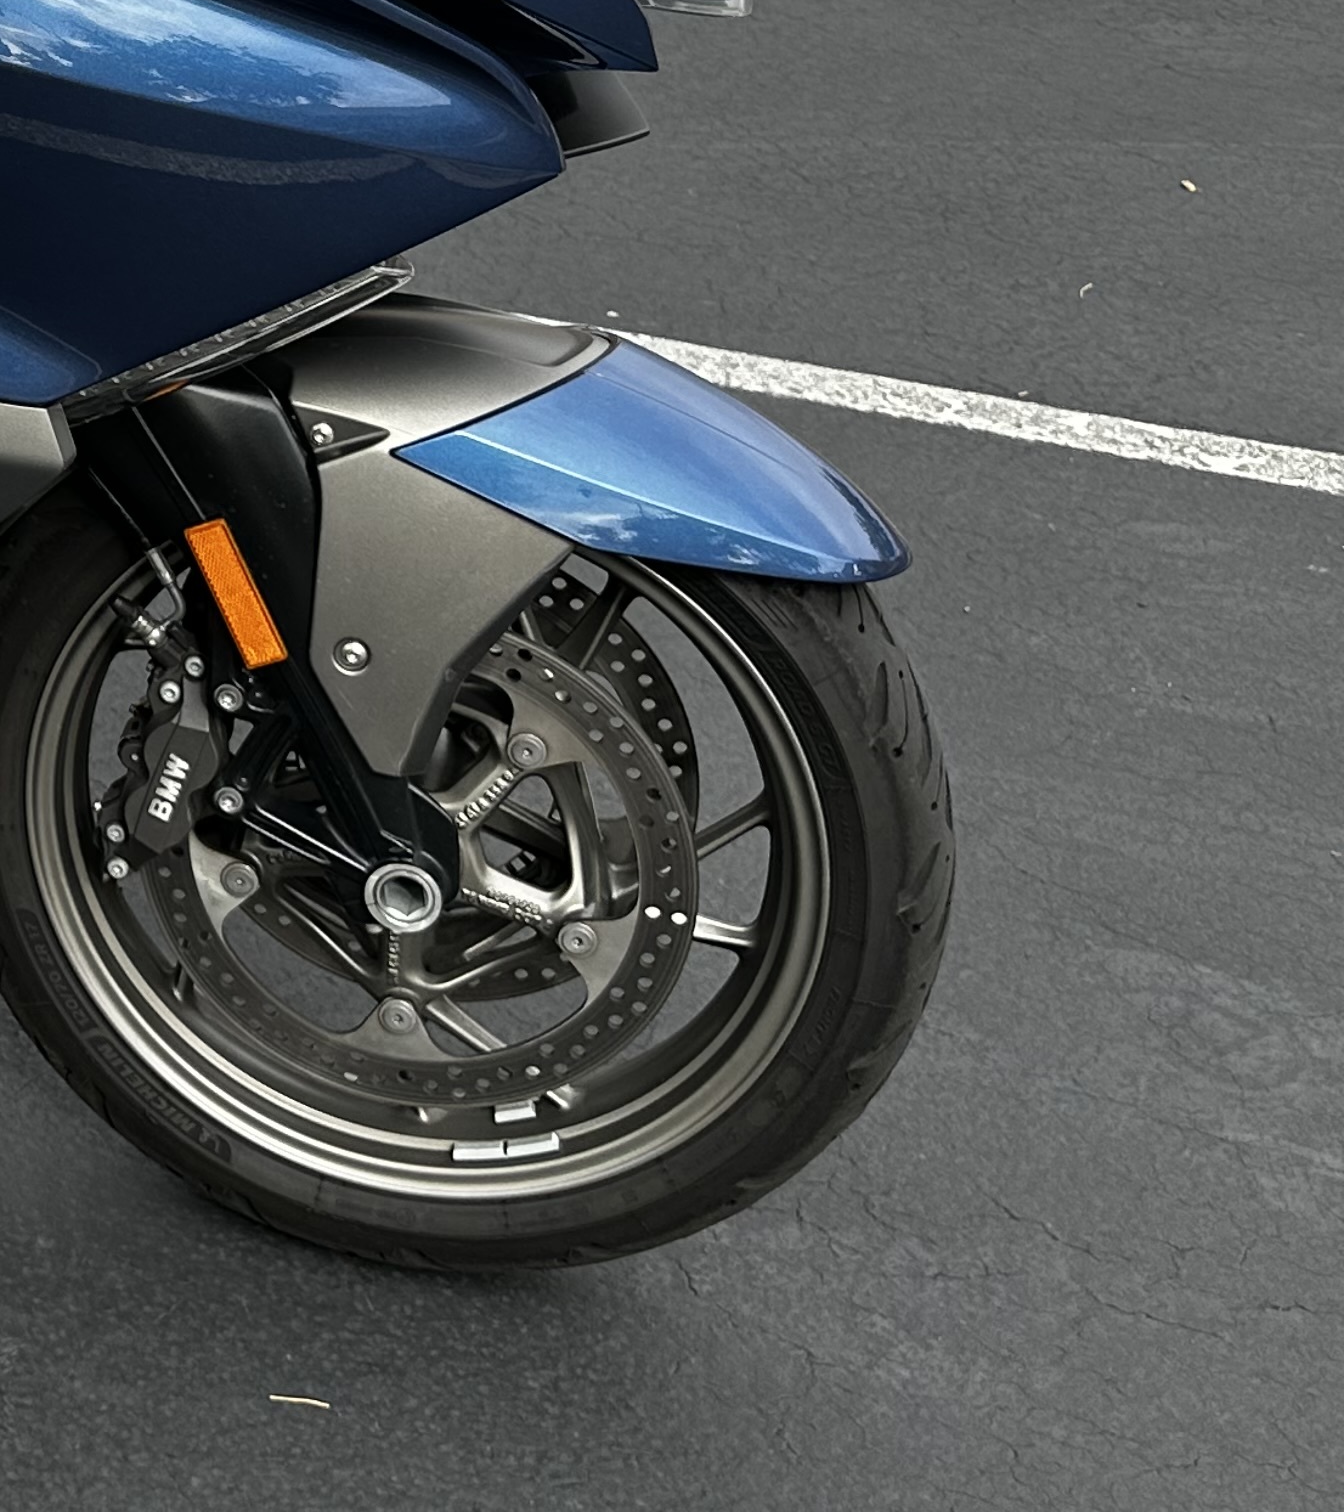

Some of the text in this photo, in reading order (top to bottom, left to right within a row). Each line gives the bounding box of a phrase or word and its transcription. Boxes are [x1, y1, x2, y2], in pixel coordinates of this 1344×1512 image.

[148, 753, 190, 821] BMW
[24, 922, 196, 1134] MICHELIN 120/70 ZR 17
